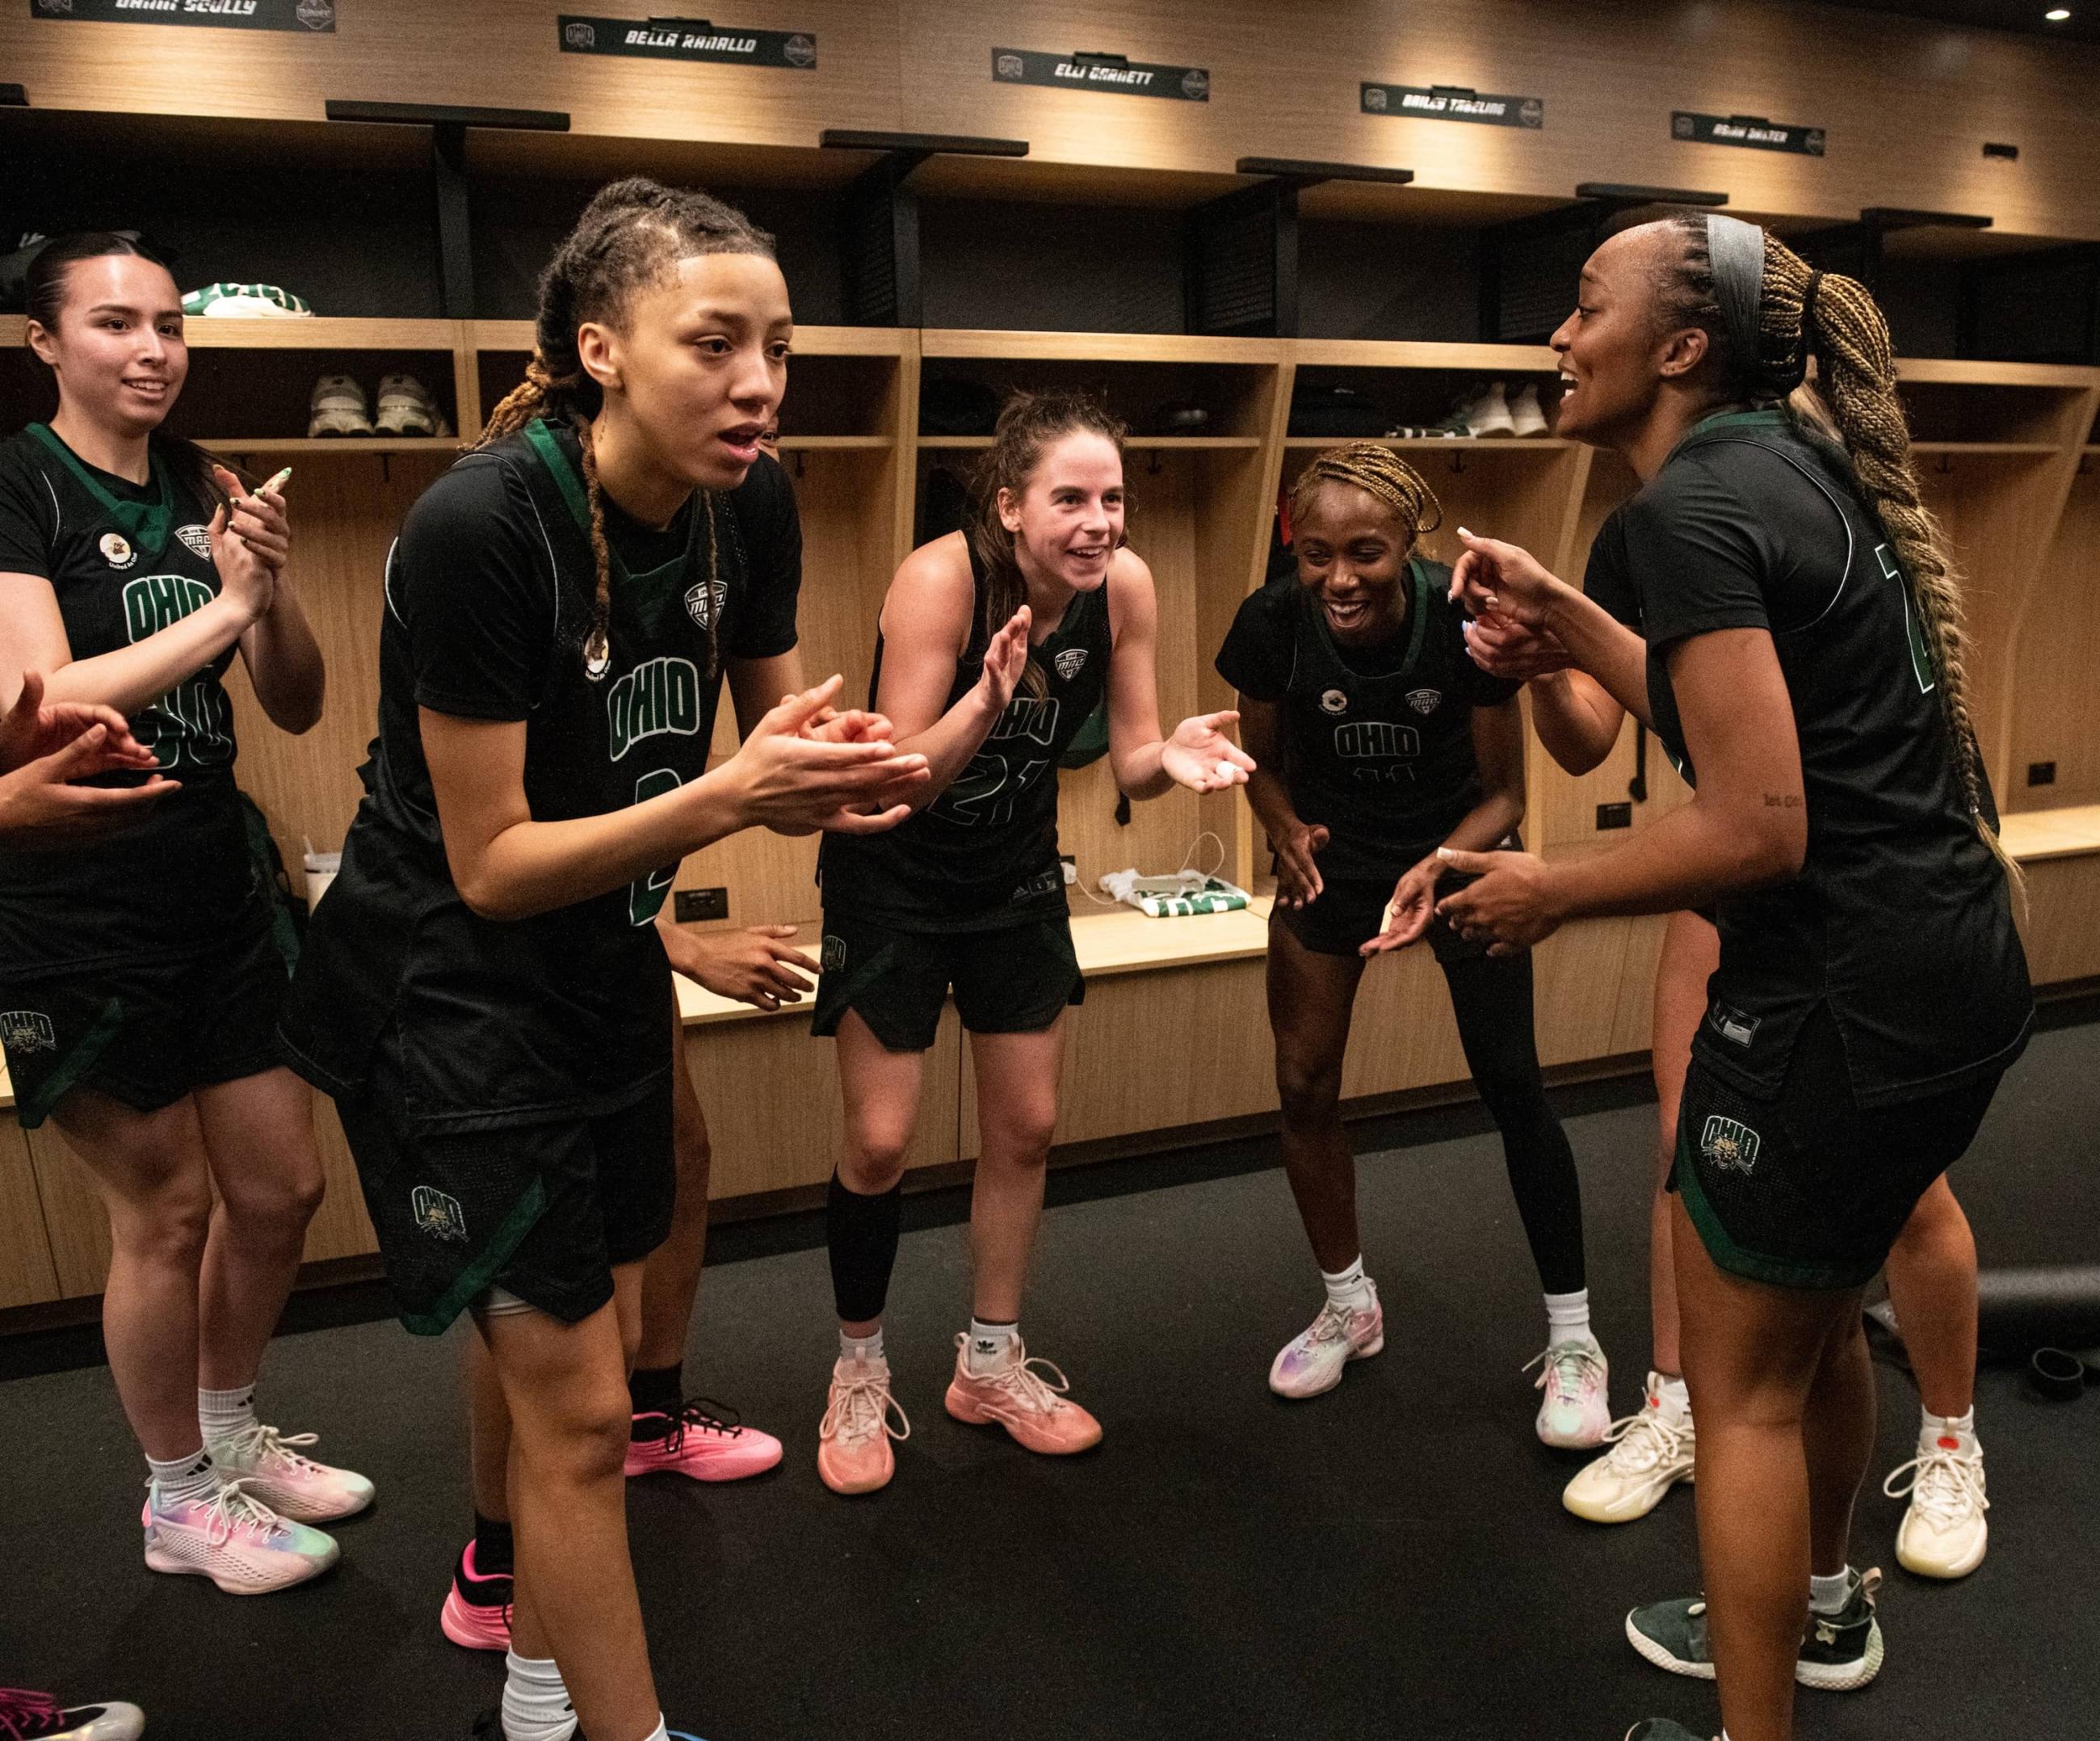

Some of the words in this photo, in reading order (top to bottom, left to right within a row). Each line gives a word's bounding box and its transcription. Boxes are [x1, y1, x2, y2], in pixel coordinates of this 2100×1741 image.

[183, 0, 257, 15] SCULLY
[624, 30, 678, 46] BELLA
[681, 33, 757, 53] RANALLO
[185, 535, 212, 545] MAC
[123, 574, 215, 644] OHIO
[1057, 658, 1085, 671] MAC
[607, 656, 700, 763] OHIO
[987, 697, 1060, 746] HIO
[1334, 721, 1421, 758] OHIO
